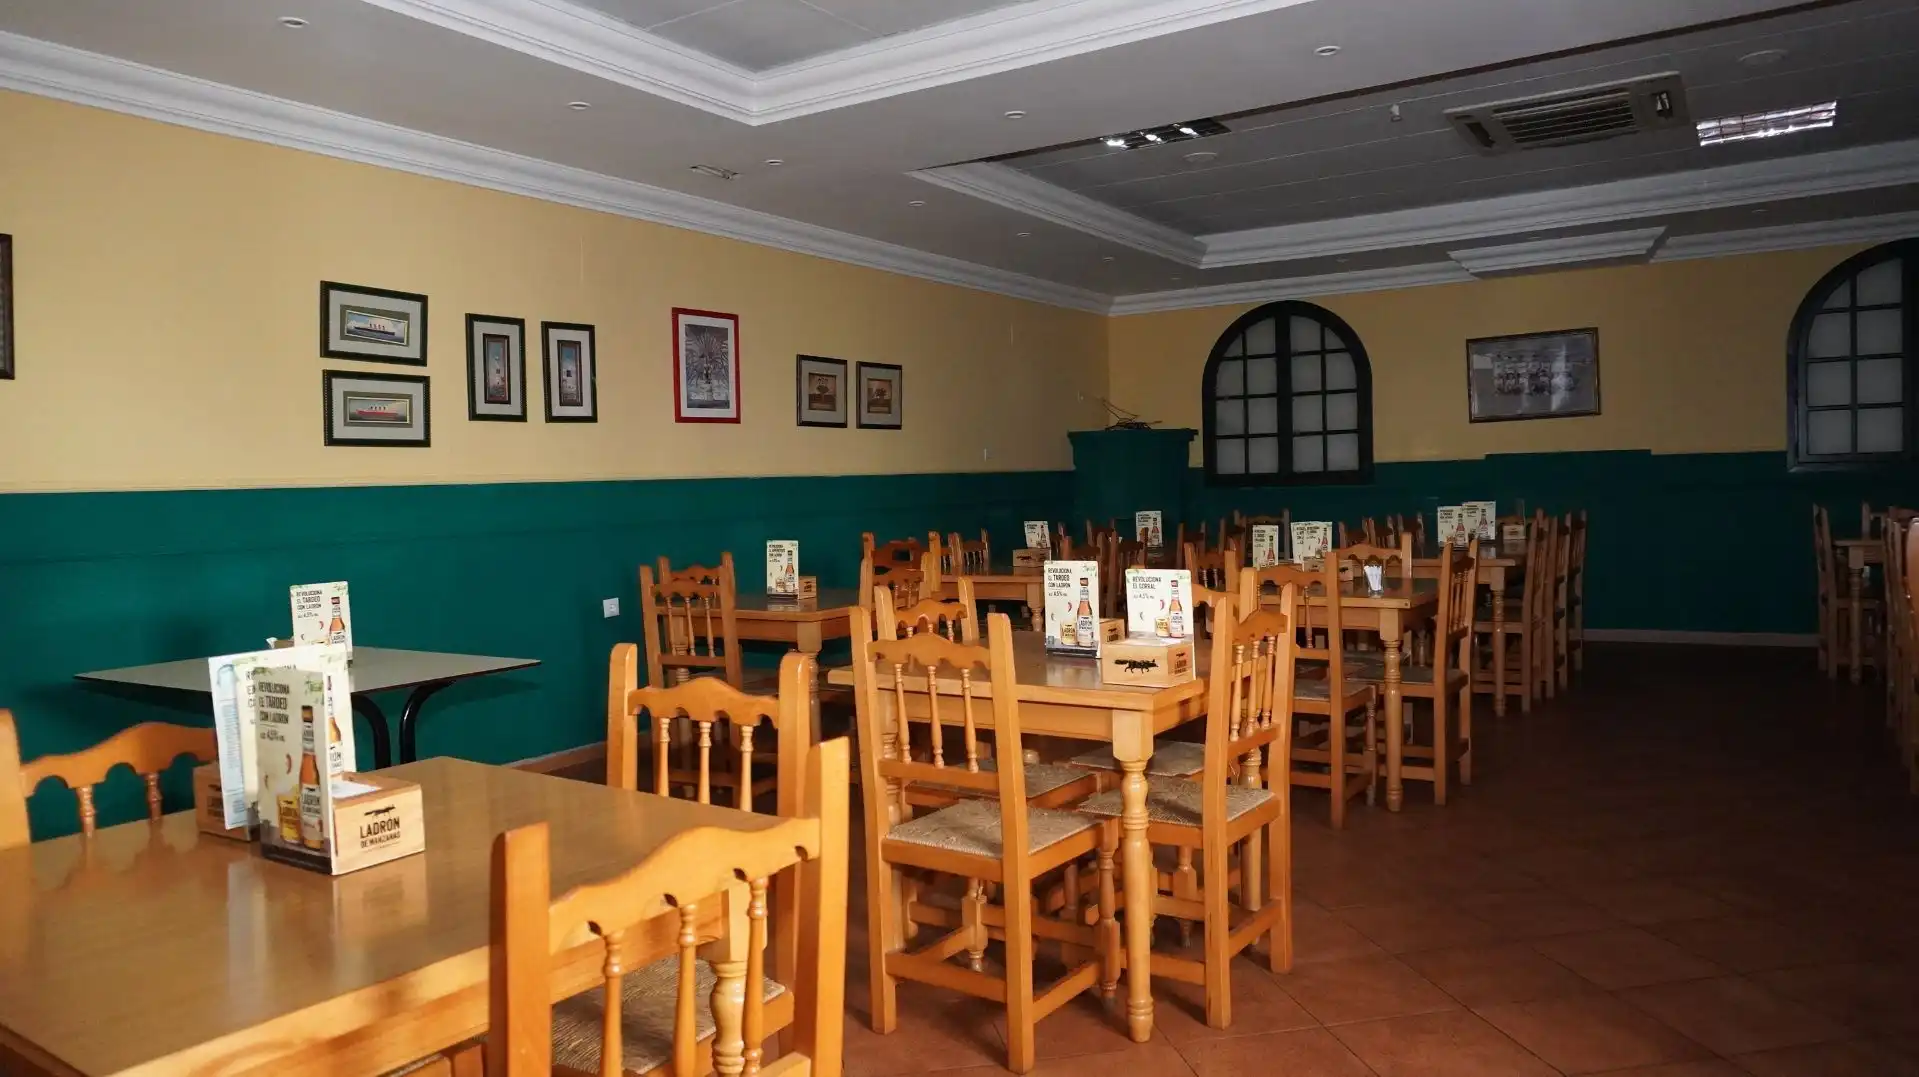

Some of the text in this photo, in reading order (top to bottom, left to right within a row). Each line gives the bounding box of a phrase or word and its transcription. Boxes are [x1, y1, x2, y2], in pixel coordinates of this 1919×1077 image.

[258, 681, 290, 695] REVOLUCIONA
[360, 839, 368, 849] DE
[369, 830, 401, 846] MANZANAS
